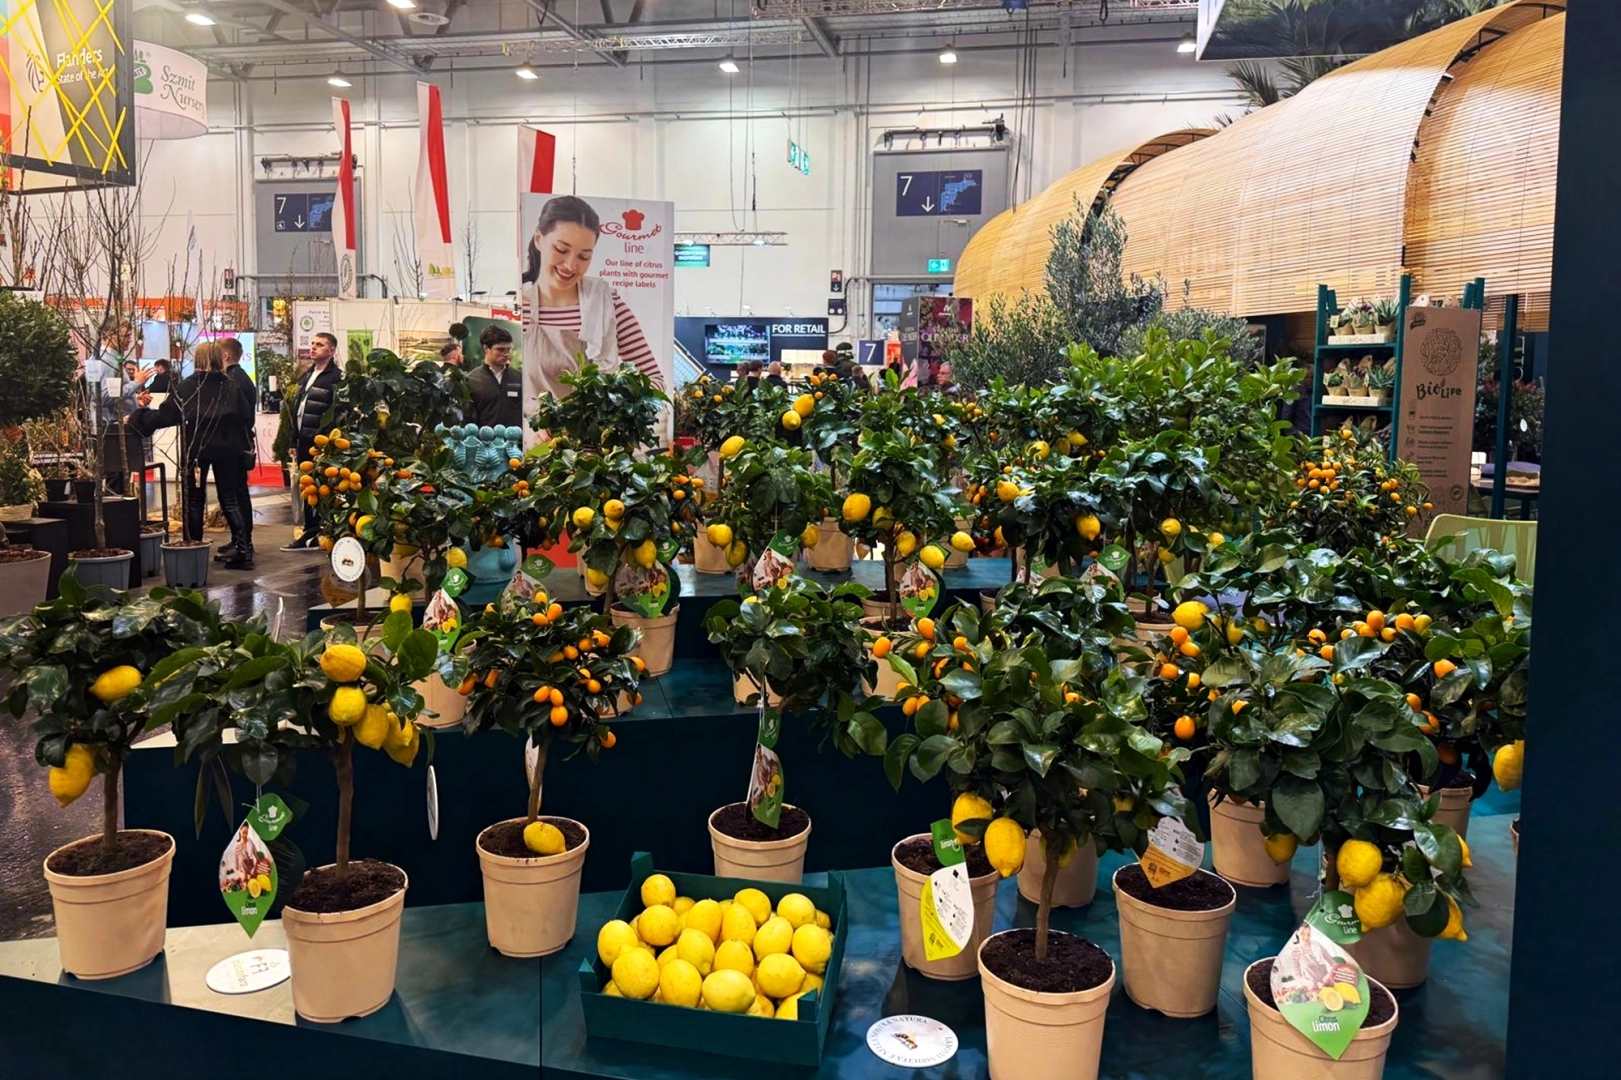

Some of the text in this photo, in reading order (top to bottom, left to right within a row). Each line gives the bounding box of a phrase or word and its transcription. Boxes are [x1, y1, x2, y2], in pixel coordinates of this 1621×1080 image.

[57, 48, 103, 68] Flanders
[76, 70, 83, 81] of
[161, 65, 195, 90] Szmit
[160, 84, 204, 119] Nursery
[900, 175, 913, 196] 7
[277, 197, 287, 214] 7
[599, 222, 662, 240] Gourmet
[624, 242, 644, 253] line
[620, 259, 633, 267] line
[599, 269, 621, 277] plants
[639, 271, 669, 279] gourmet
[612, 280, 633, 288] recipe
[772, 324, 825, 334] FOR RETAIL
[865, 343, 875, 361] 7
[1324, 912, 1361, 926] Gourm
[1343, 925, 1358, 934] line
[891, 1016, 929, 1024] NATURA
[1312, 1021, 1340, 1032] limon
